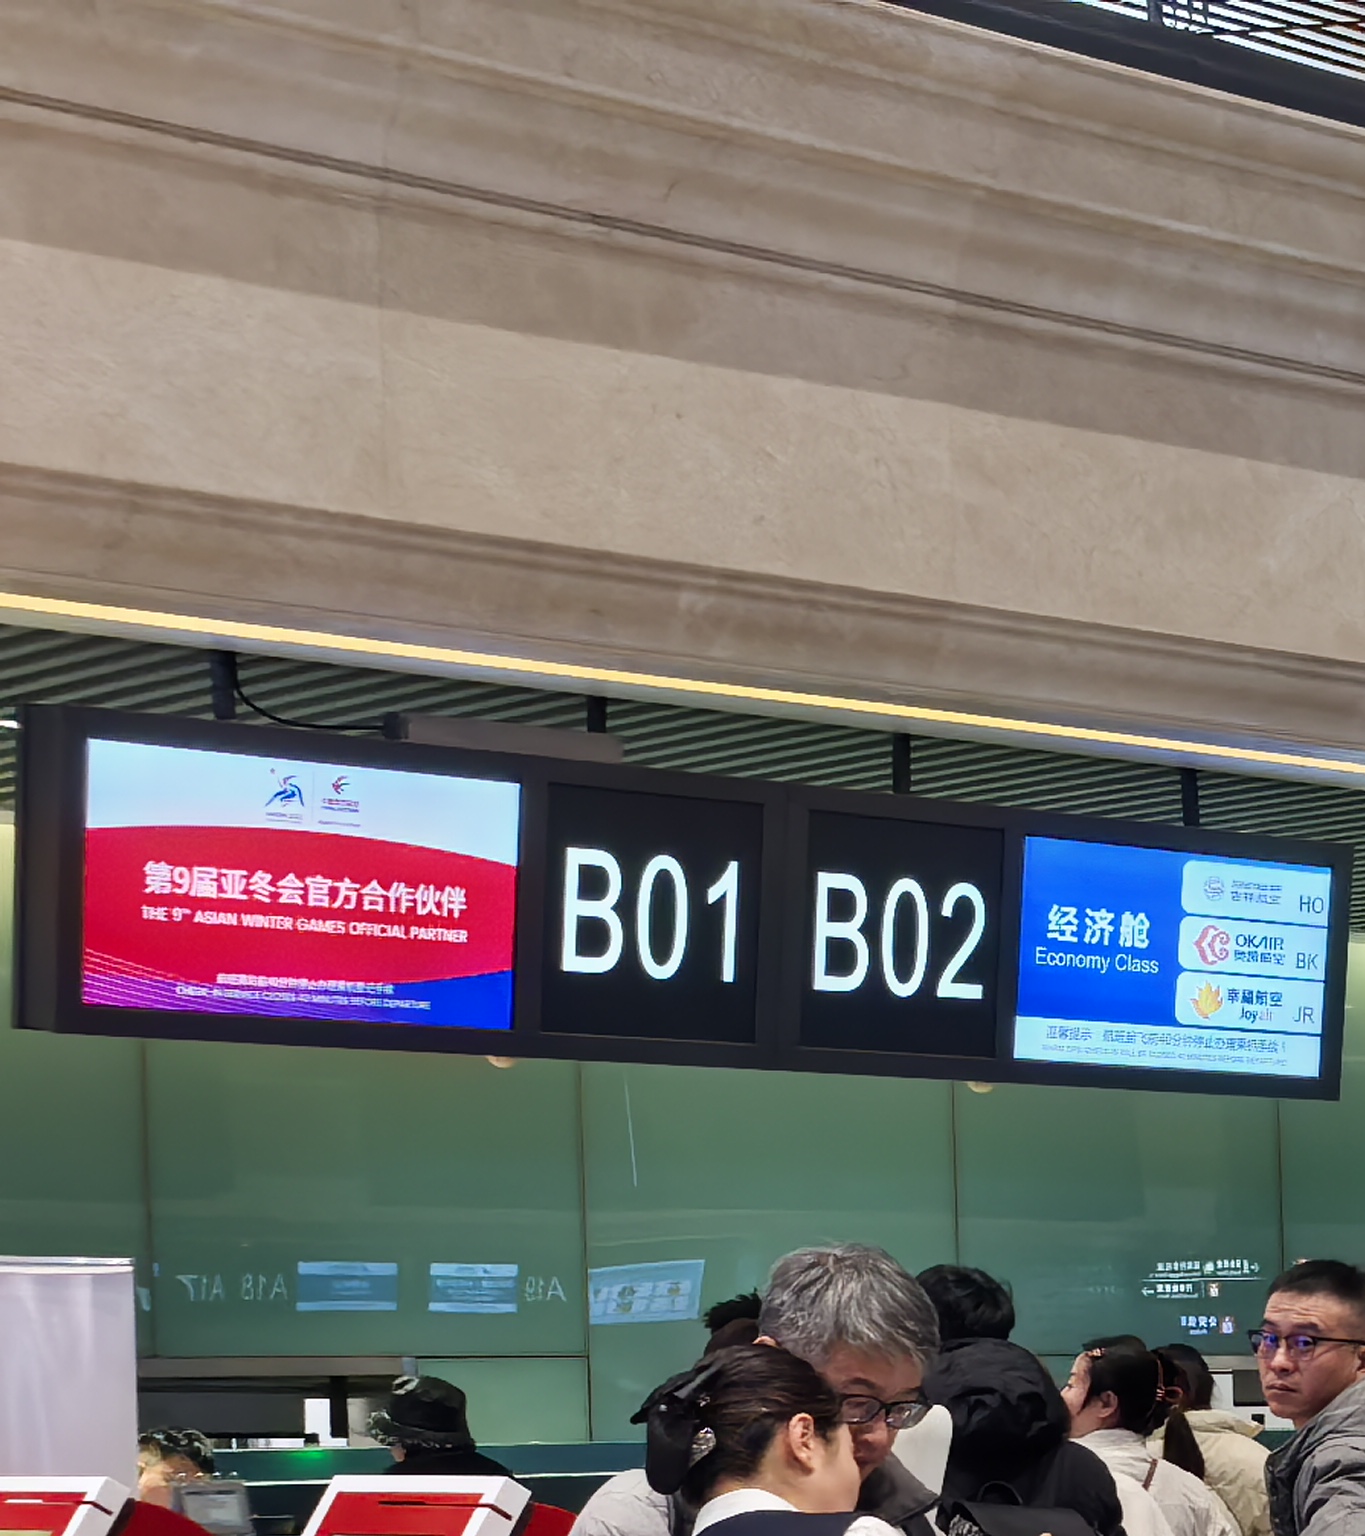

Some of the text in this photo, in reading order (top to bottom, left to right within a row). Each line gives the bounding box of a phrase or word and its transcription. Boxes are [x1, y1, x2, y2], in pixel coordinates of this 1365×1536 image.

[142, 860, 468, 919] 第9届亚冬会官方合作伙伴
[1299, 895, 1324, 915] HO
[193, 910, 238, 927] ASIAN
[240, 913, 294, 932] WINTER
[297, 918, 346, 936] GAMES
[349, 921, 407, 940] OFFICIAL
[410, 925, 469, 944] PARTNER
[562, 847, 738, 983] B01
[1046, 903, 1150, 950] 经济舱
[813, 871, 985, 999] B02
[1035, 946, 1160, 974] Economy Class
[1295, 952, 1318, 970] BK
[1293, 1007, 1314, 1024] JR
